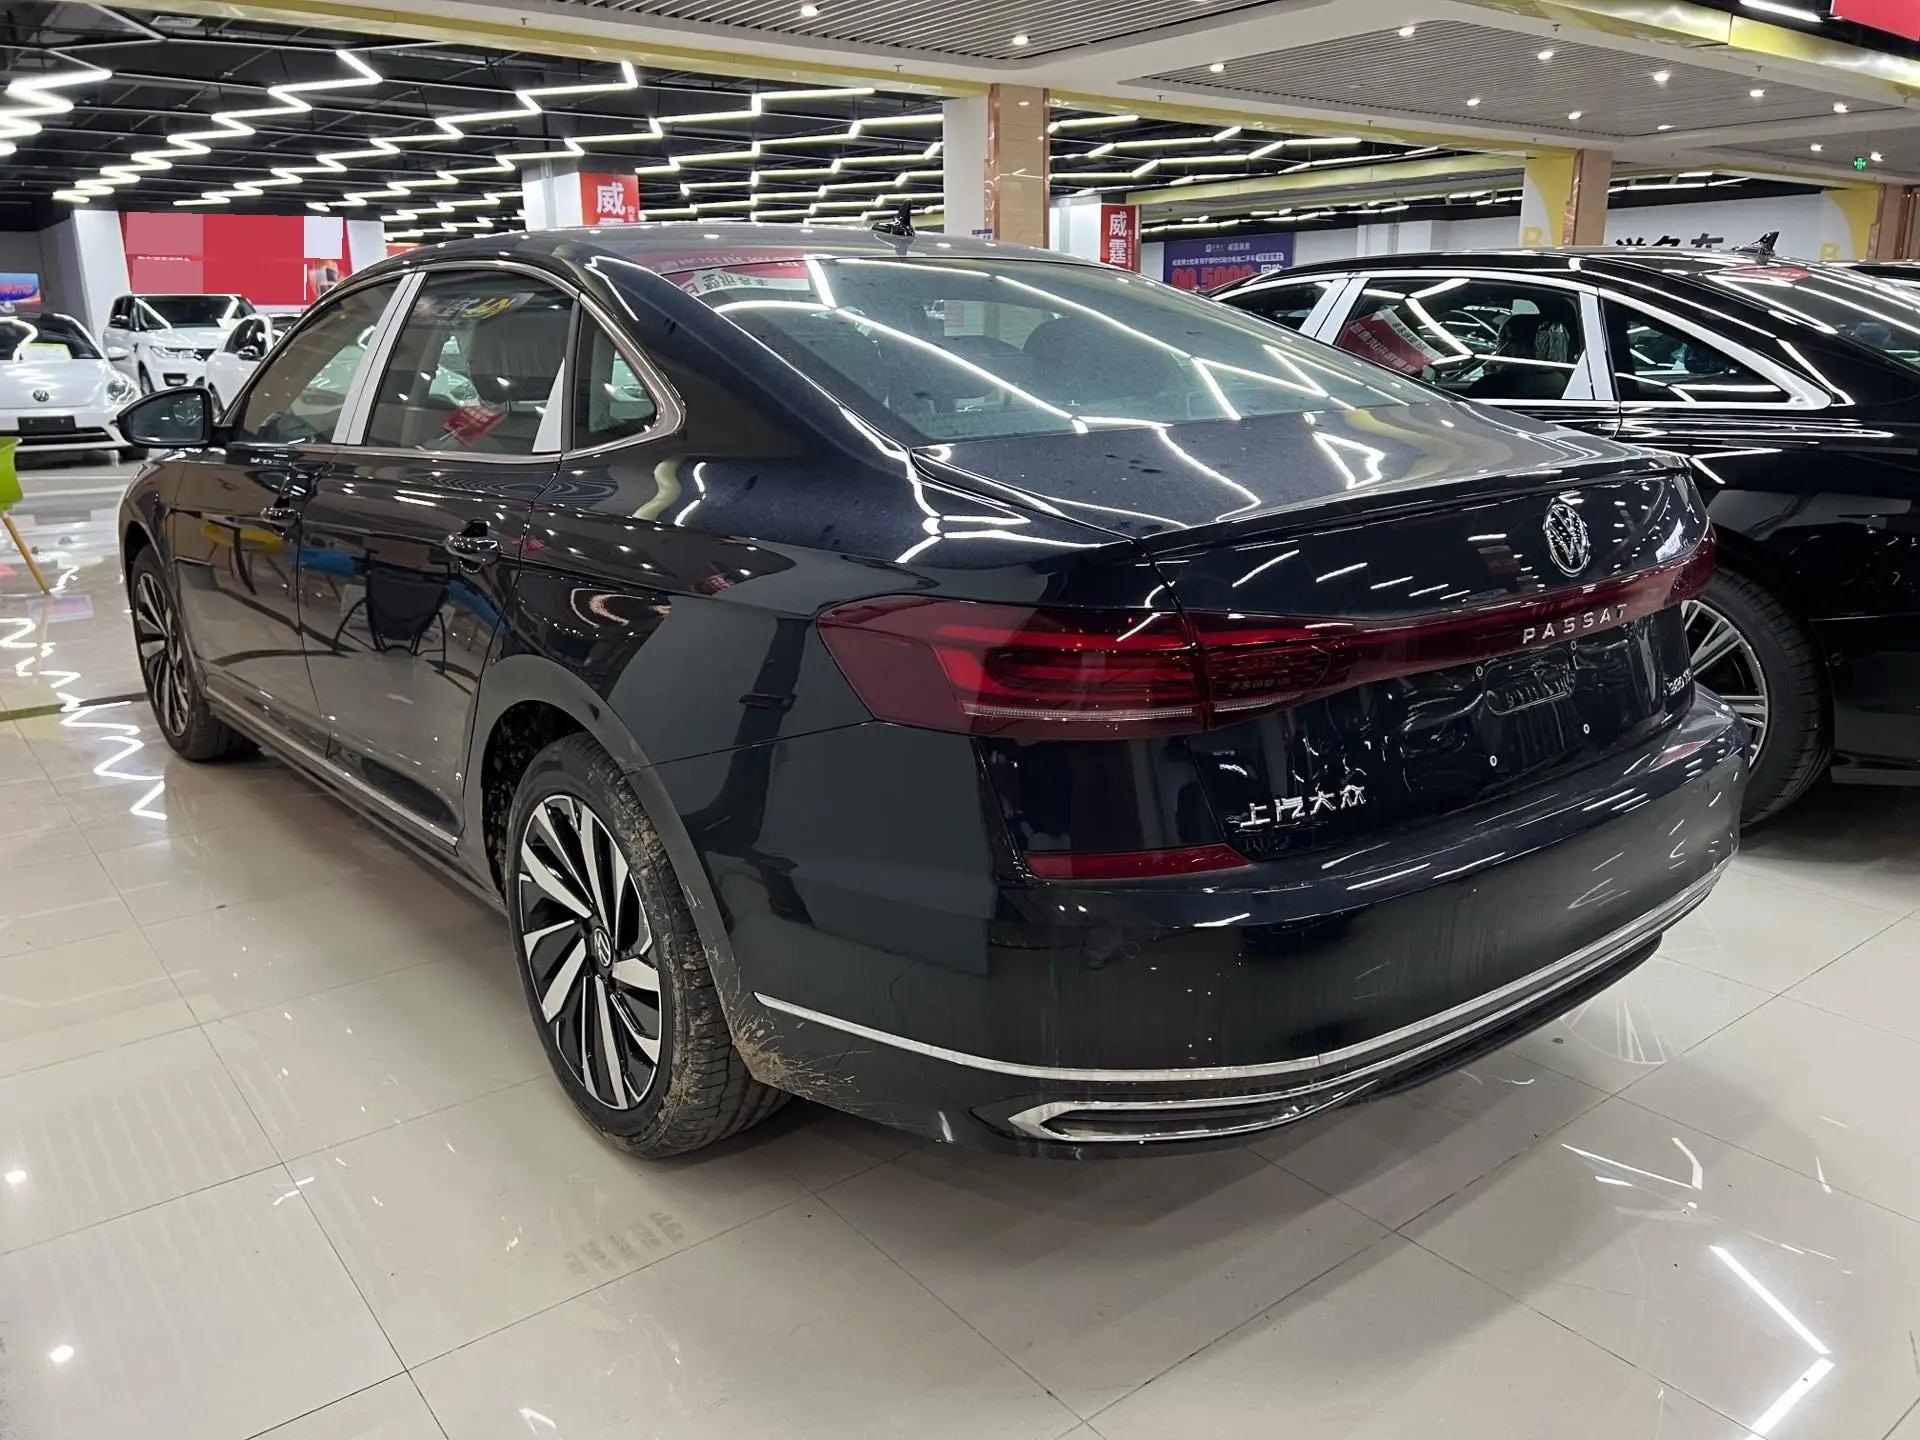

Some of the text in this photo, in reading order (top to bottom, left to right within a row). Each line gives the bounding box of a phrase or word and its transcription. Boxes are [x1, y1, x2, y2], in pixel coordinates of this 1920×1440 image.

[1109, 210, 1128, 264] 威霆
[1522, 603, 1628, 645] PASSAT
[1239, 784, 1367, 829] 上汽大众
